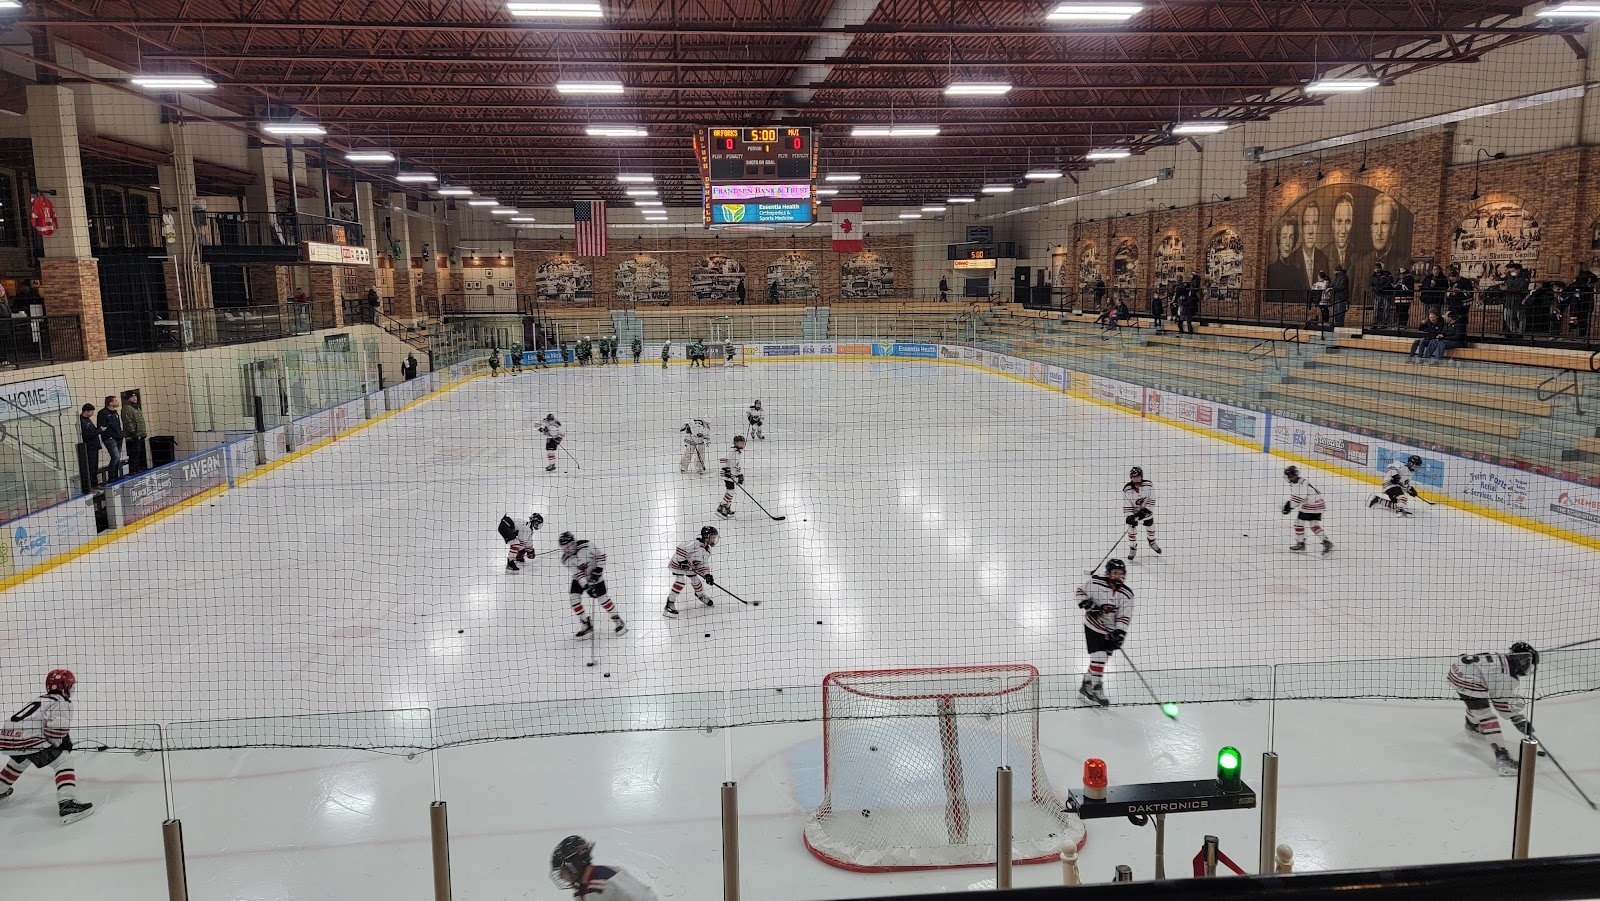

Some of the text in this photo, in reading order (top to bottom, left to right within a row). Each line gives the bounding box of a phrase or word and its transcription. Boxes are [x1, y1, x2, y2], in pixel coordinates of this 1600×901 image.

[751, 130, 776, 141] 5:00
[726, 138, 733, 149] 0
[794, 137, 801, 149] 0
[1489, 252, 1512, 260] Skating
[1514, 250, 1540, 258] Capital
[8, 388, 47, 408] HOME
[183, 454, 220, 481] TAVERN
[1470, 471, 1507, 490] Twin Ports
[1480, 481, 1497, 492] Aerial
[1128, 800, 1209, 813] DAKTRONICS
